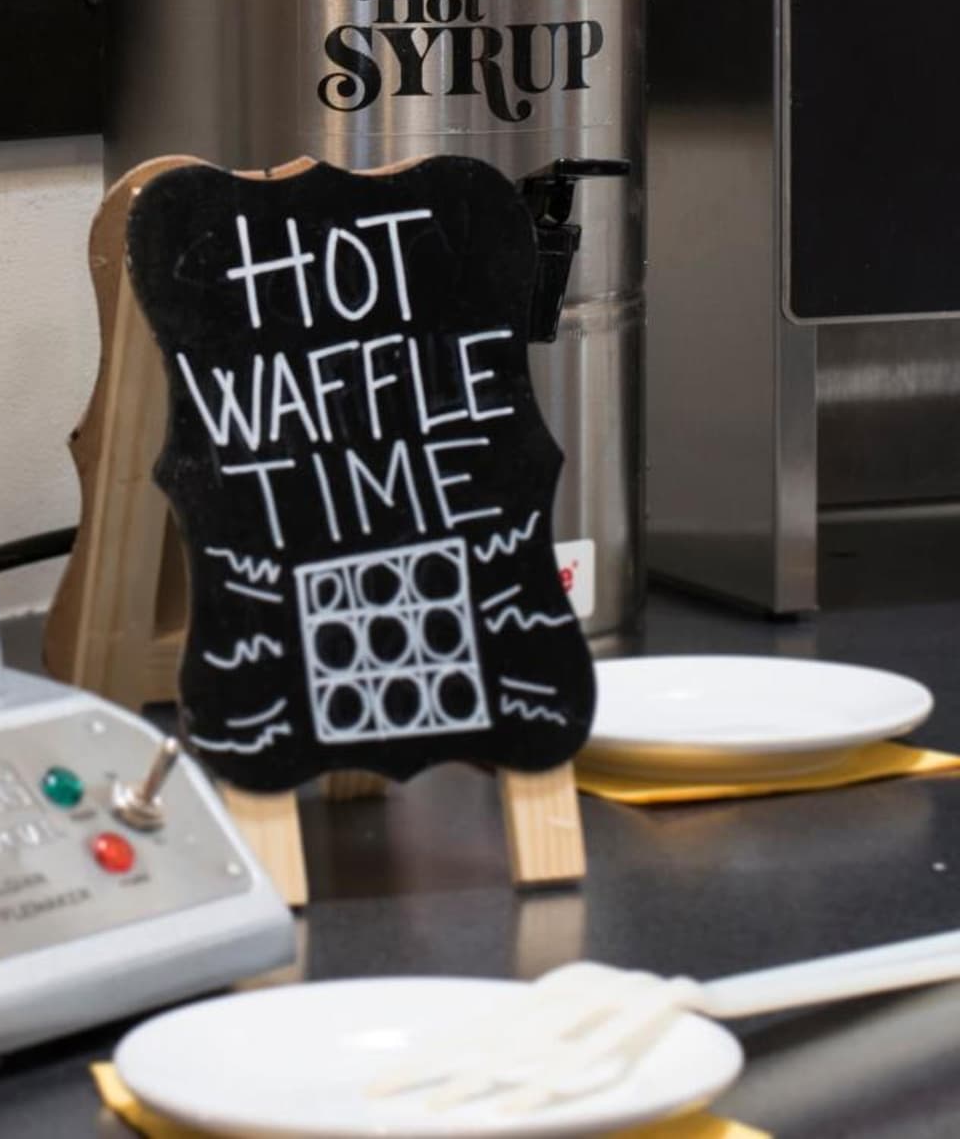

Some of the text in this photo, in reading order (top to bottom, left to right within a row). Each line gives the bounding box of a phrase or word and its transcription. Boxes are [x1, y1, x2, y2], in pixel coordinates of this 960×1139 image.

[317, 20, 604, 123] SYRUP
[227, 209, 432, 328] HOT
[177, 330, 514, 451] WAFFLE
[221, 437, 502, 548] TIME
